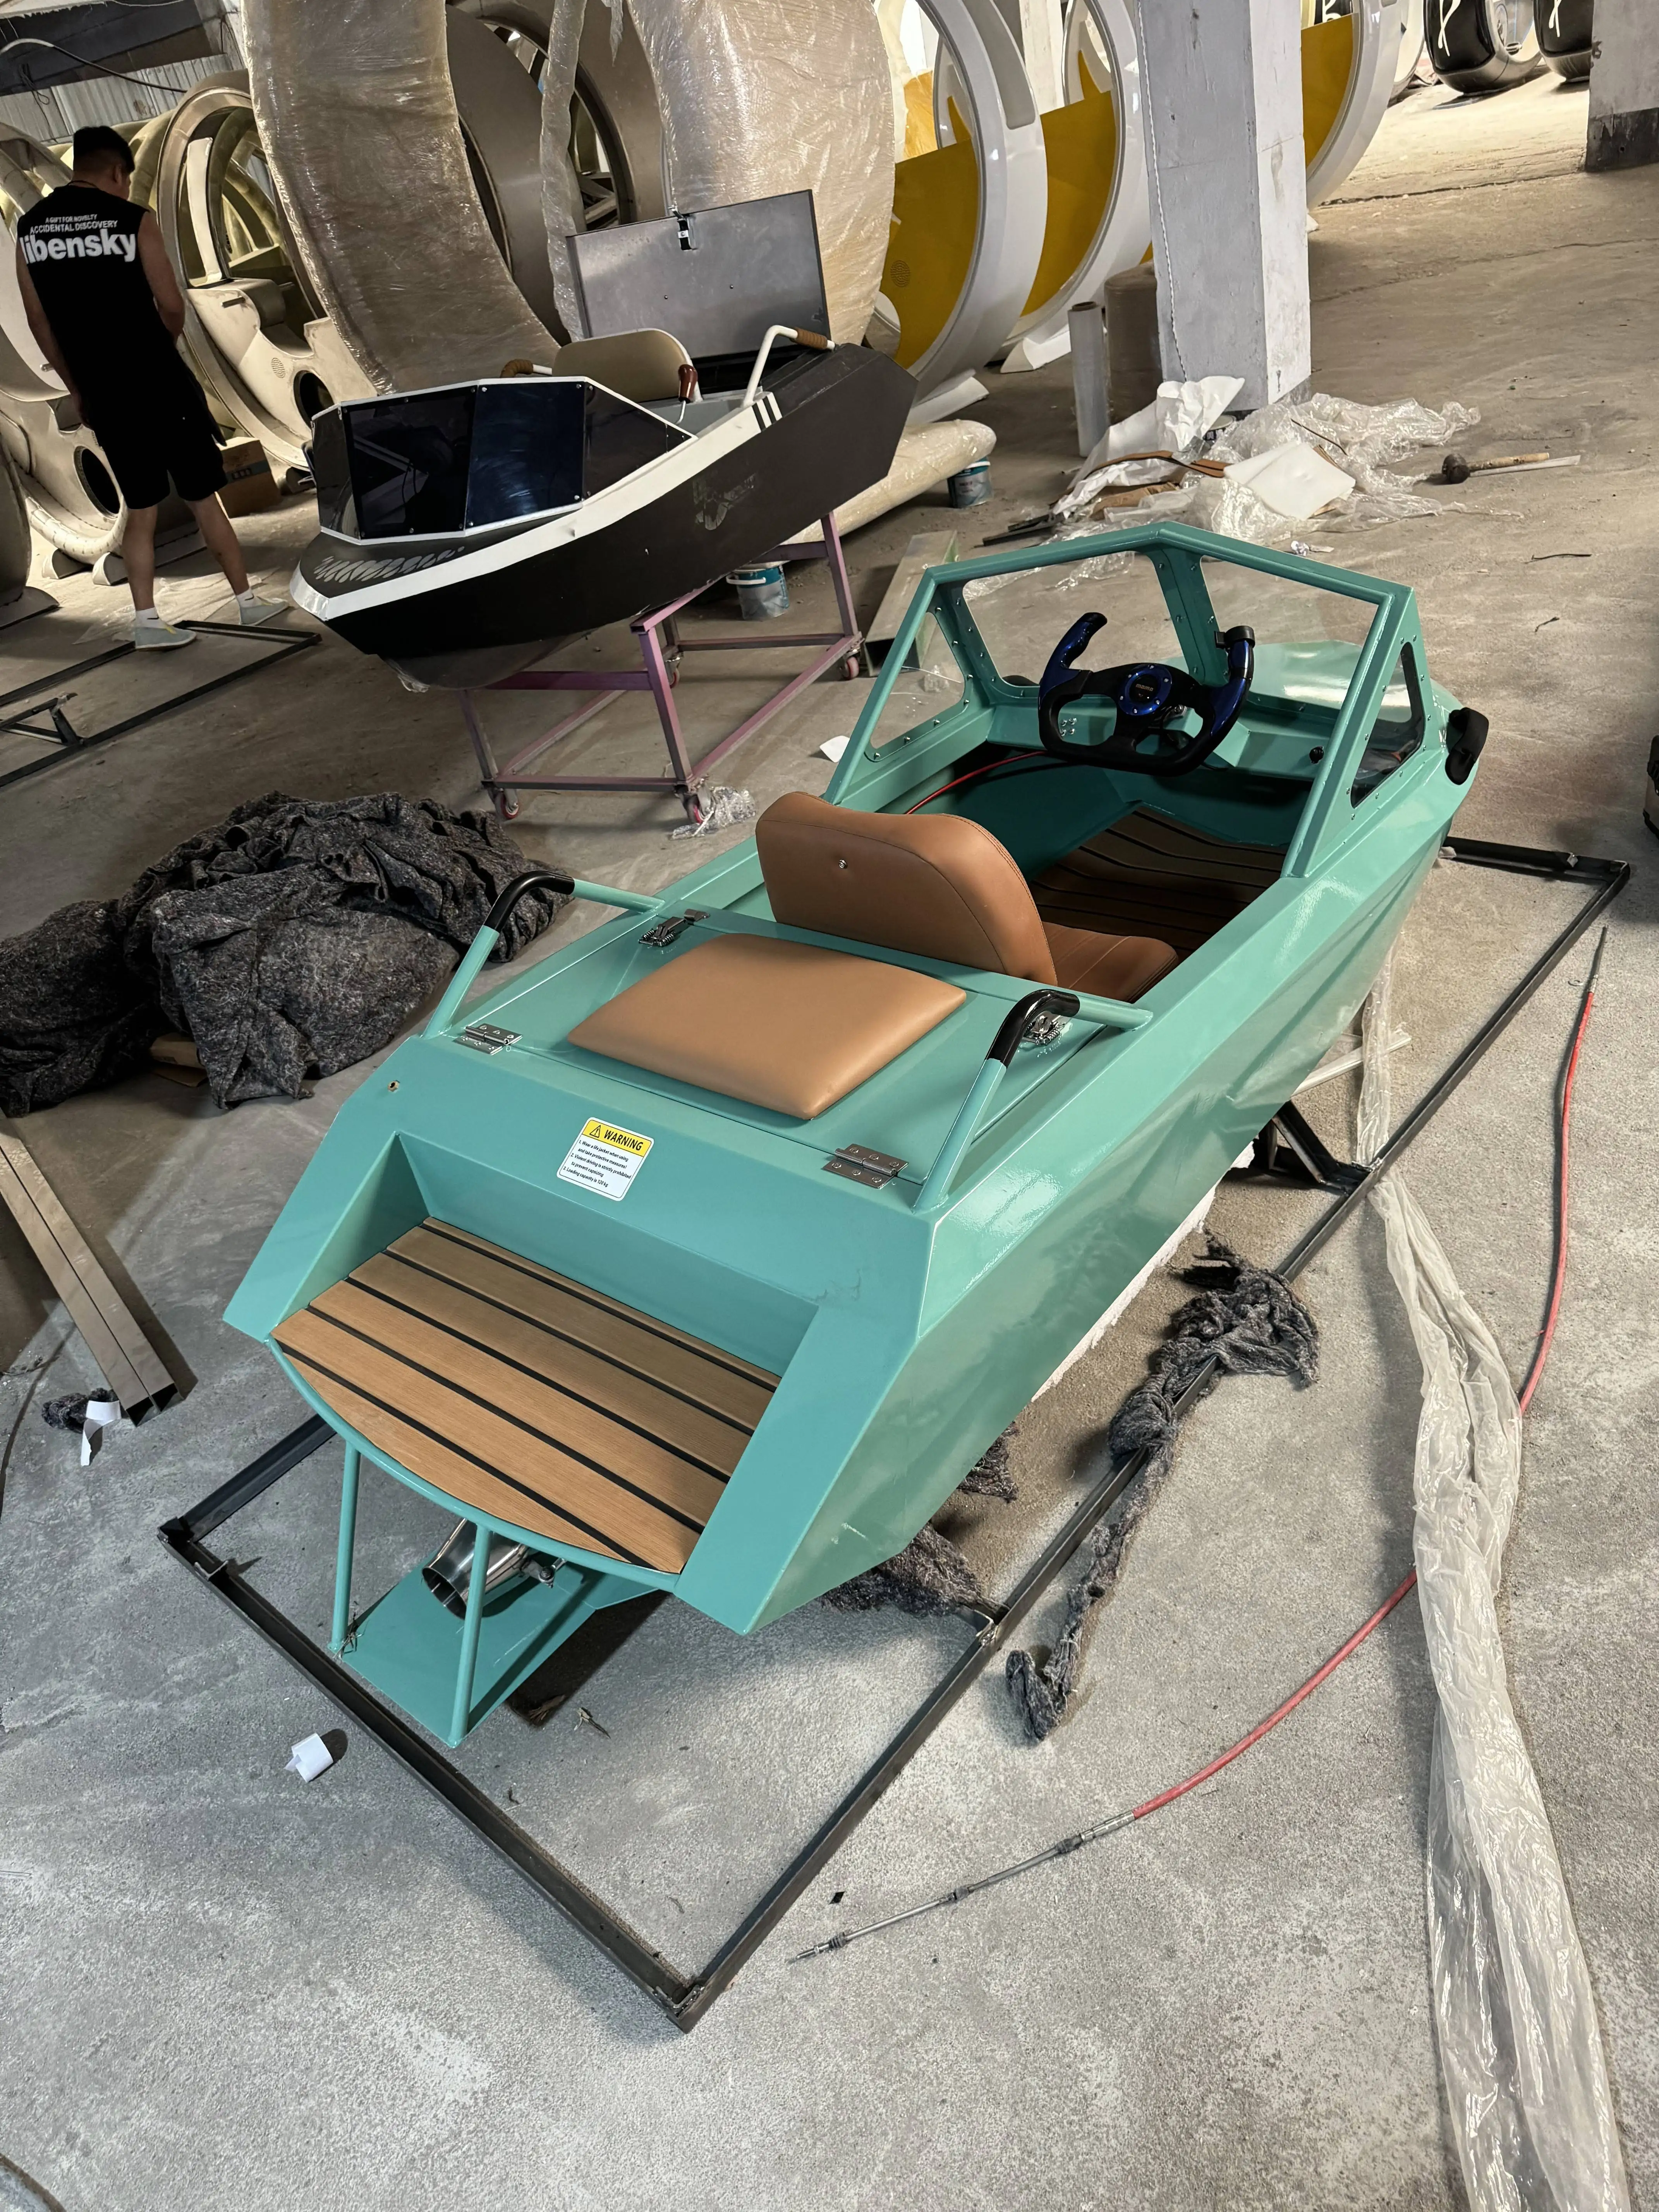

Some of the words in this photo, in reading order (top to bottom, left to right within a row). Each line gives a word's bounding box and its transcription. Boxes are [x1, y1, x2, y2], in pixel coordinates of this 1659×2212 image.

[74, 214, 97, 222] NOVELTY
[29, 223, 74, 235] ACCIDENTAL
[75, 220, 118, 231] DISCOVERY
[19, 228, 136, 264] libensky
[604, 1129, 643, 1151] WARNING
[591, 1154, 609, 1162] protective
[574, 1154, 587, 1162] Violent
[586, 1159, 598, 1167] driving
[613, 1170, 632, 1179] prohibited
[566, 1167, 580, 1176] Loading
[580, 1173, 593, 1182] capacity
